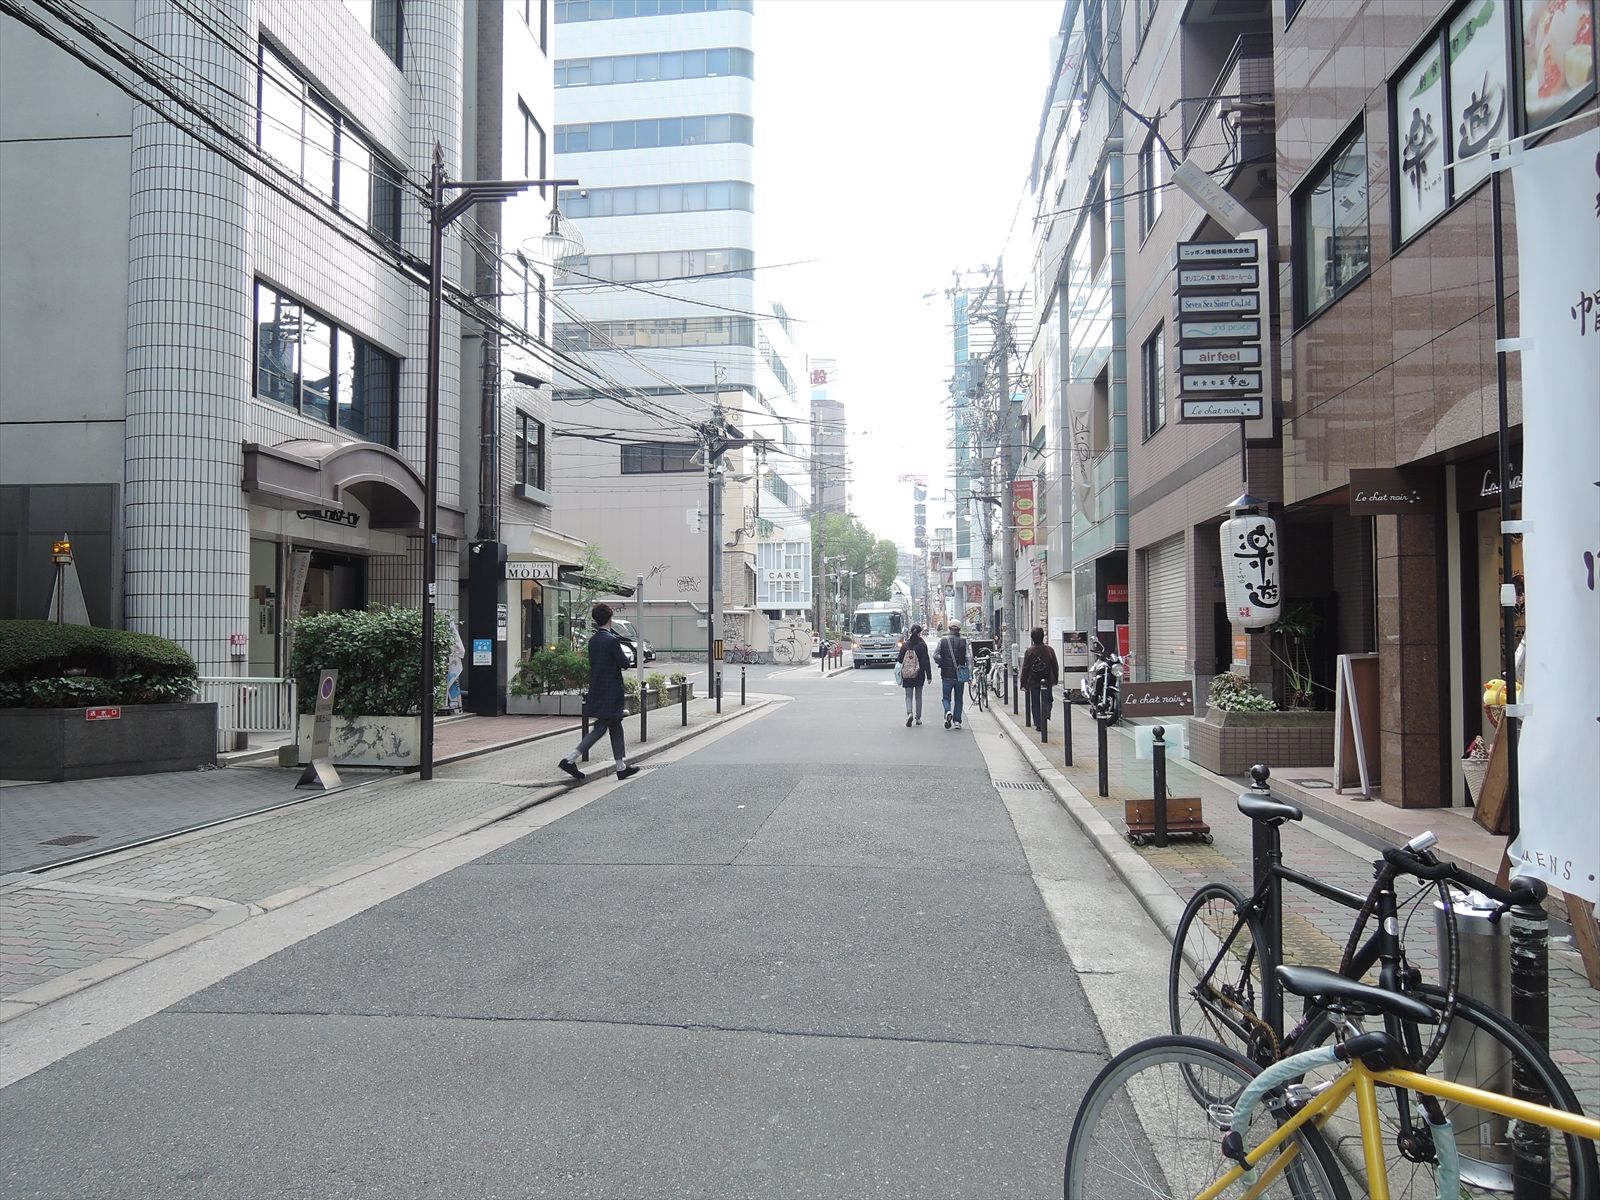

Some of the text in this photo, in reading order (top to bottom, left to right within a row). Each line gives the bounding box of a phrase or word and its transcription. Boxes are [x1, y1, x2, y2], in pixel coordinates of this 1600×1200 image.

[1184, 248, 1250, 256] ニッポン情報技術株式会社
[1203, 300, 1213, 308] Sea
[1213, 299, 1230, 307] Sister
[1191, 405, 1202, 415] Le
[1204, 405, 1222, 415] chat
[1355, 491, 1409, 502] Le chat noir
[508, 568, 550, 578] MODA
[1124, 692, 1183, 705] Le chat noir
